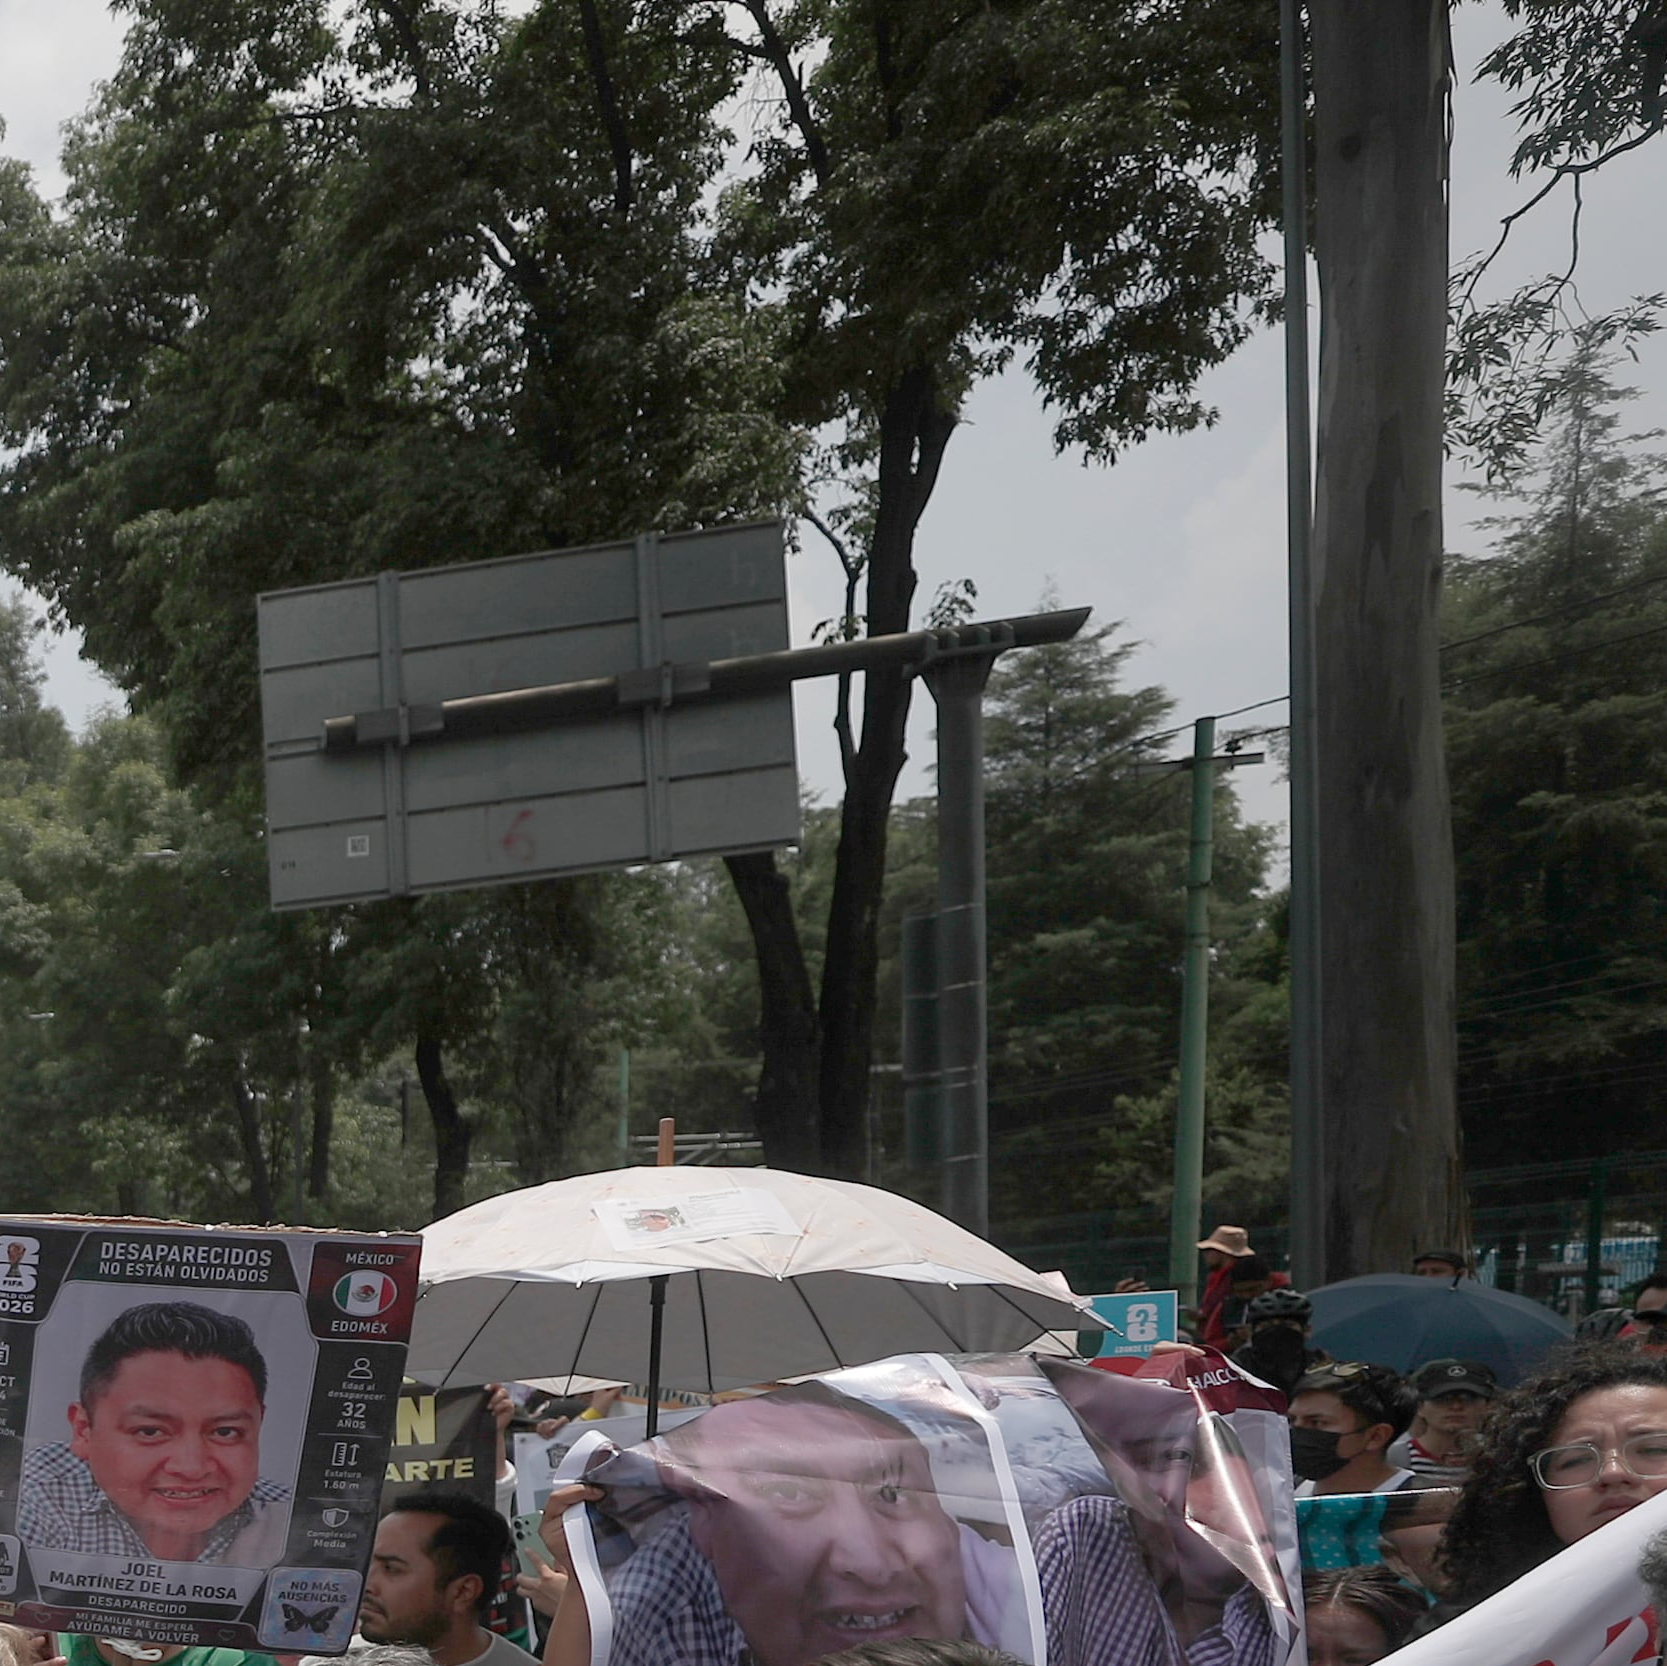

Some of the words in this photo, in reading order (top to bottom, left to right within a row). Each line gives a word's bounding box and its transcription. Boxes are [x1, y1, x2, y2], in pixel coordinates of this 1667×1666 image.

[100, 1242, 272, 1266] DESAPARECIDOS
[346, 1251, 394, 1265] MÉXICO
[99, 1262, 119, 1276] NO
[126, 1261, 175, 1278] ESTÁN
[180, 1265, 268, 1282] OLVIDADOS
[331, 1320, 388, 1334] EDOMÉX
[342, 1382, 364, 1391] Edad
[367, 1383, 376, 1391] al
[341, 1402, 366, 1418] 32
[337, 1419, 366, 1429] AÑOS
[325, 1469, 362, 1479] Estatura
[313, 1539, 346, 1548] Media
[122, 1562, 165, 1579] JOEL
[49, 1570, 136, 1592] MARTÍNEZ
[140, 1581, 161, 1594] DE
[166, 1583, 187, 1596] LA
[193, 1585, 237, 1600] ROSA
[291, 1581, 307, 1591] NO
[311, 1580, 339, 1591] MÁS
[278, 1591, 347, 1603] AUSENCIAS
[89, 1595, 187, 1615] DESAPARECIDO
[76, 1612, 90, 1621] MI
[91, 1613, 133, 1625] FAMILIA
[136, 1618, 150, 1627] ME
[154, 1620, 194, 1632] ESPERA
[67, 1620, 131, 1637] AYÚDAME
[135, 1628, 143, 1638] A
[148, 1629, 199, 1644] VOLVER
